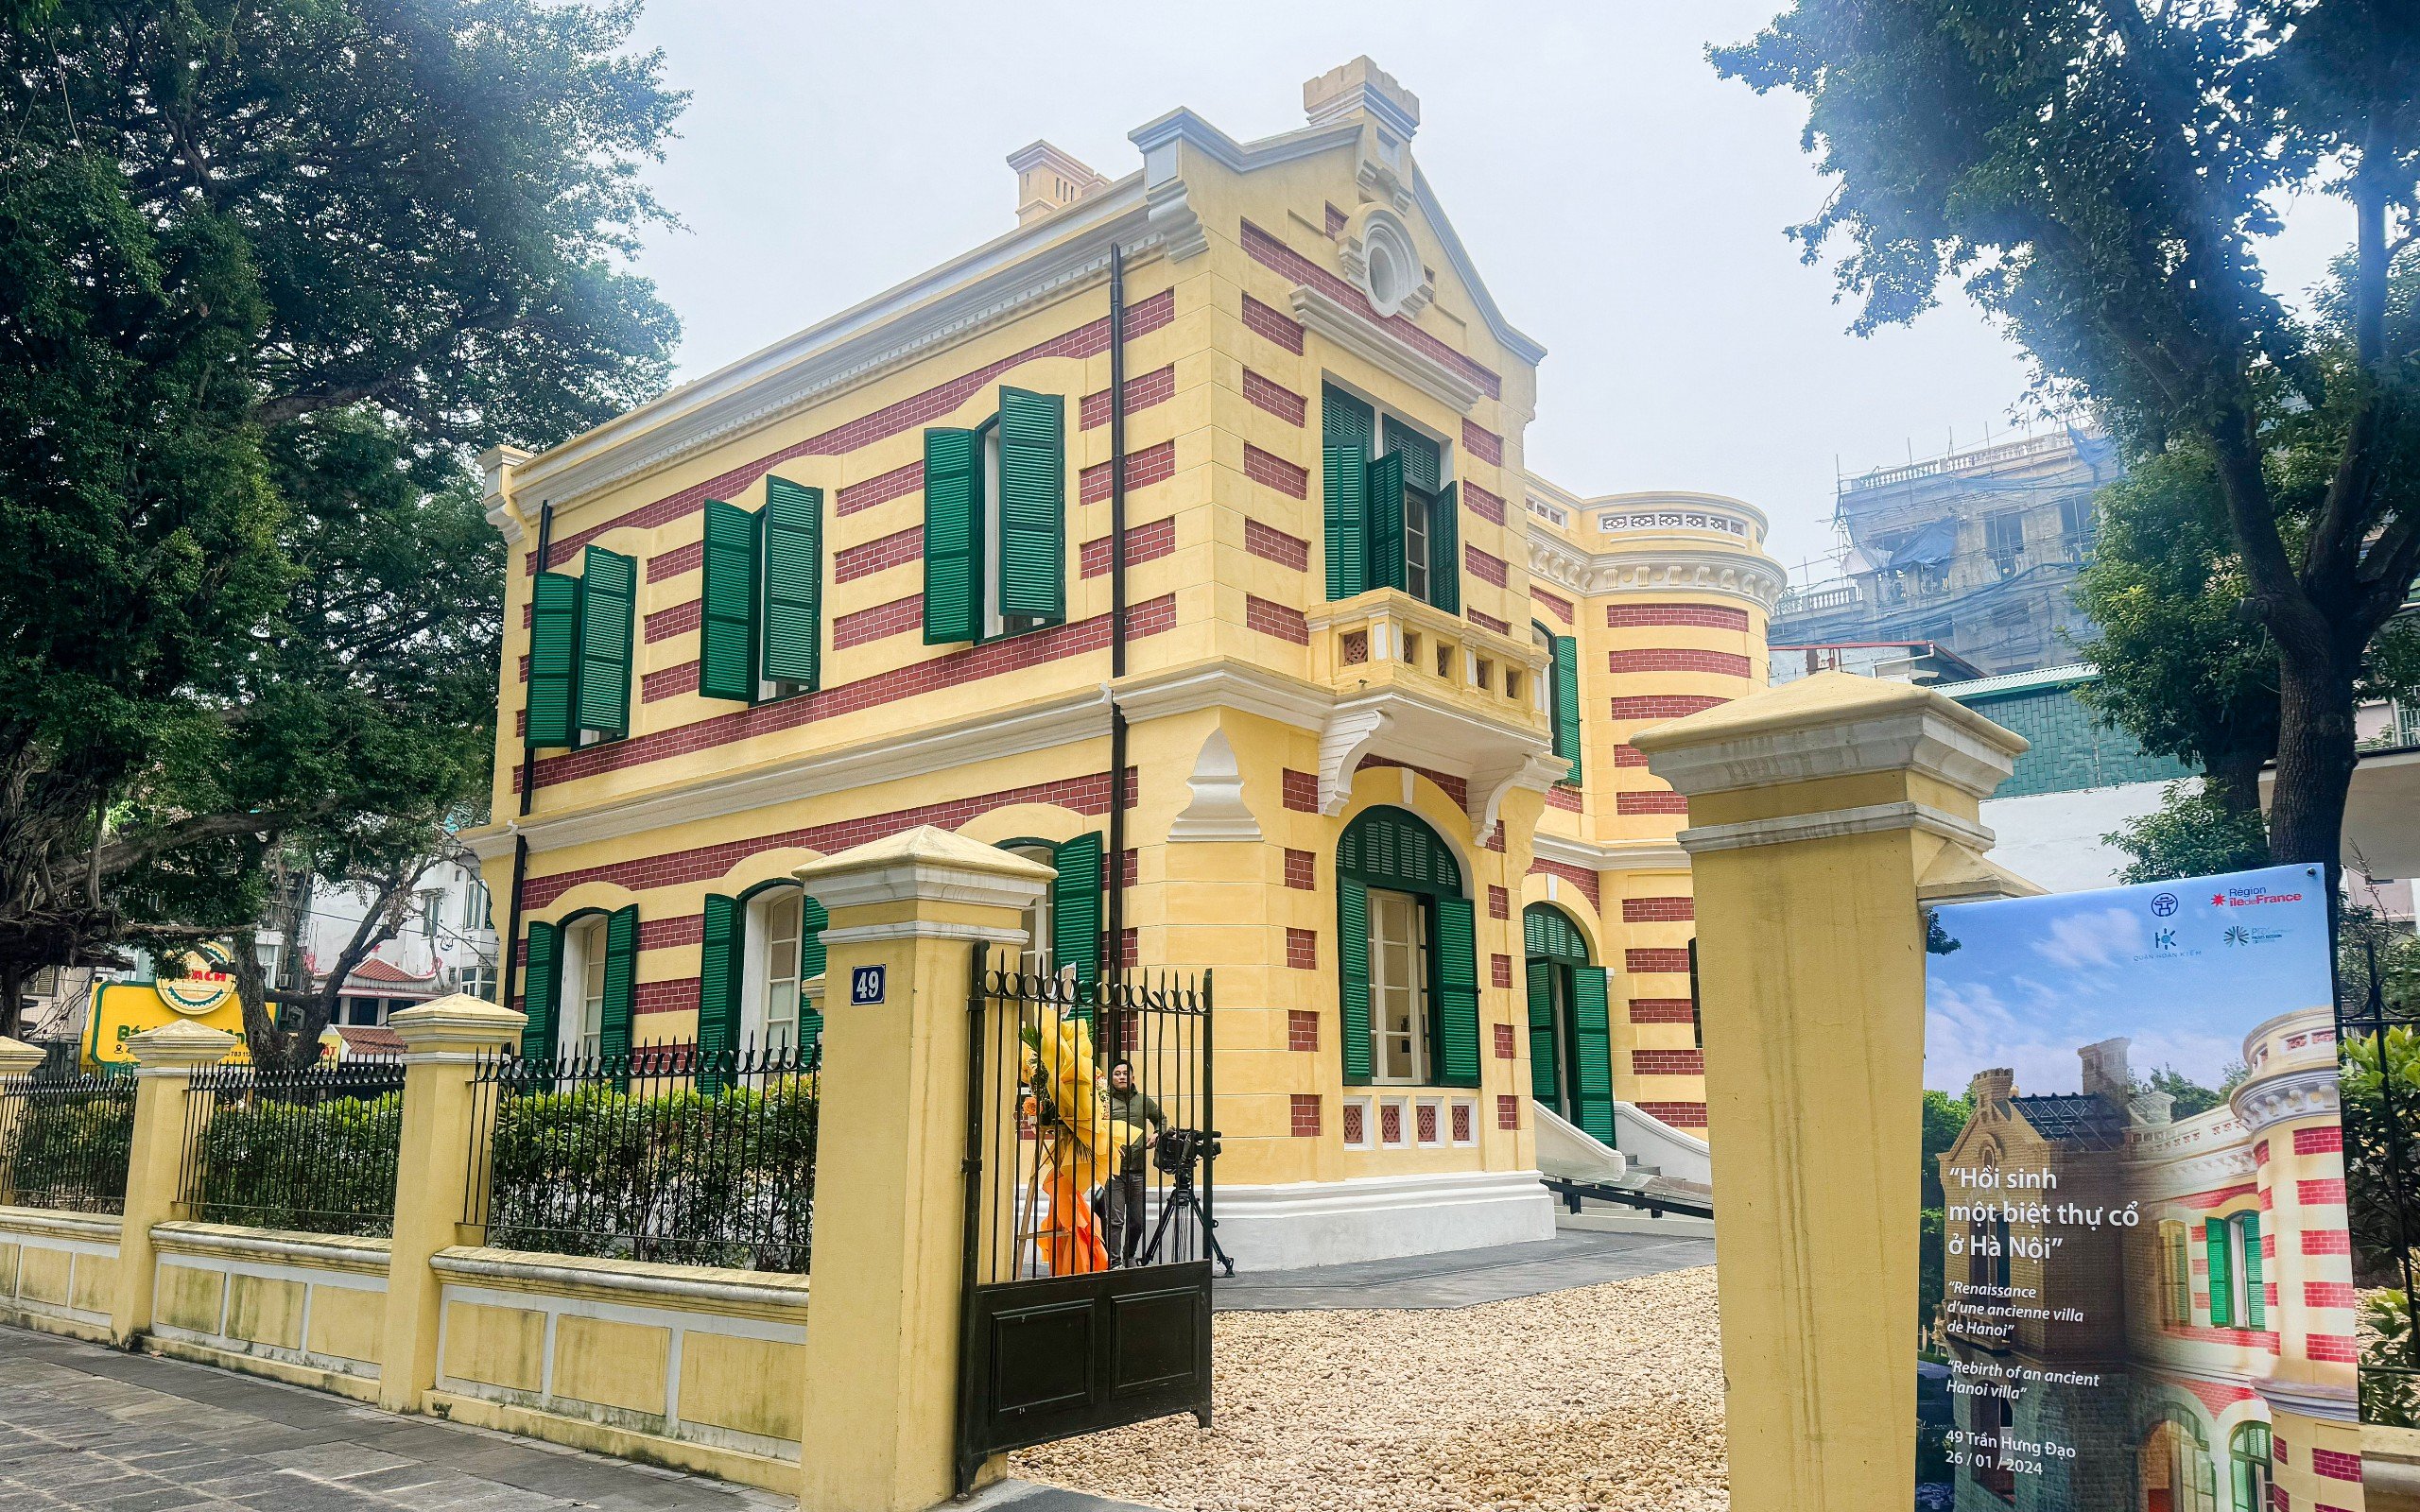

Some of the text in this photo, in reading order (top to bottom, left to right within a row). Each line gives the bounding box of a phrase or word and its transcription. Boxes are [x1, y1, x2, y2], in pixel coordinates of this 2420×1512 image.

[2229, 886, 2267, 898] Région
[856, 971, 879, 999] 49
[1949, 1164, 2057, 1190] “Hồi sinh
[1949, 1200, 2139, 1231] một biệt thự cổ
[1948, 1233, 2063, 1264] ở Hà Nội”
[1948, 1280, 2037, 1298] “Renaissance
[1946, 1299, 2084, 1323] d’une ancienne villa
[1946, 1320, 2014, 1337] de Hanoi”
[1947, 1360, 2100, 1386] “Rebirth of an ancient
[1945, 1380, 2028, 1400] Hanoi villa”
[1945, 1430, 2076, 1461] 49 Trần Hưng Đạo
[1945, 1450, 2043, 1475] 26 / 01 / 2024
